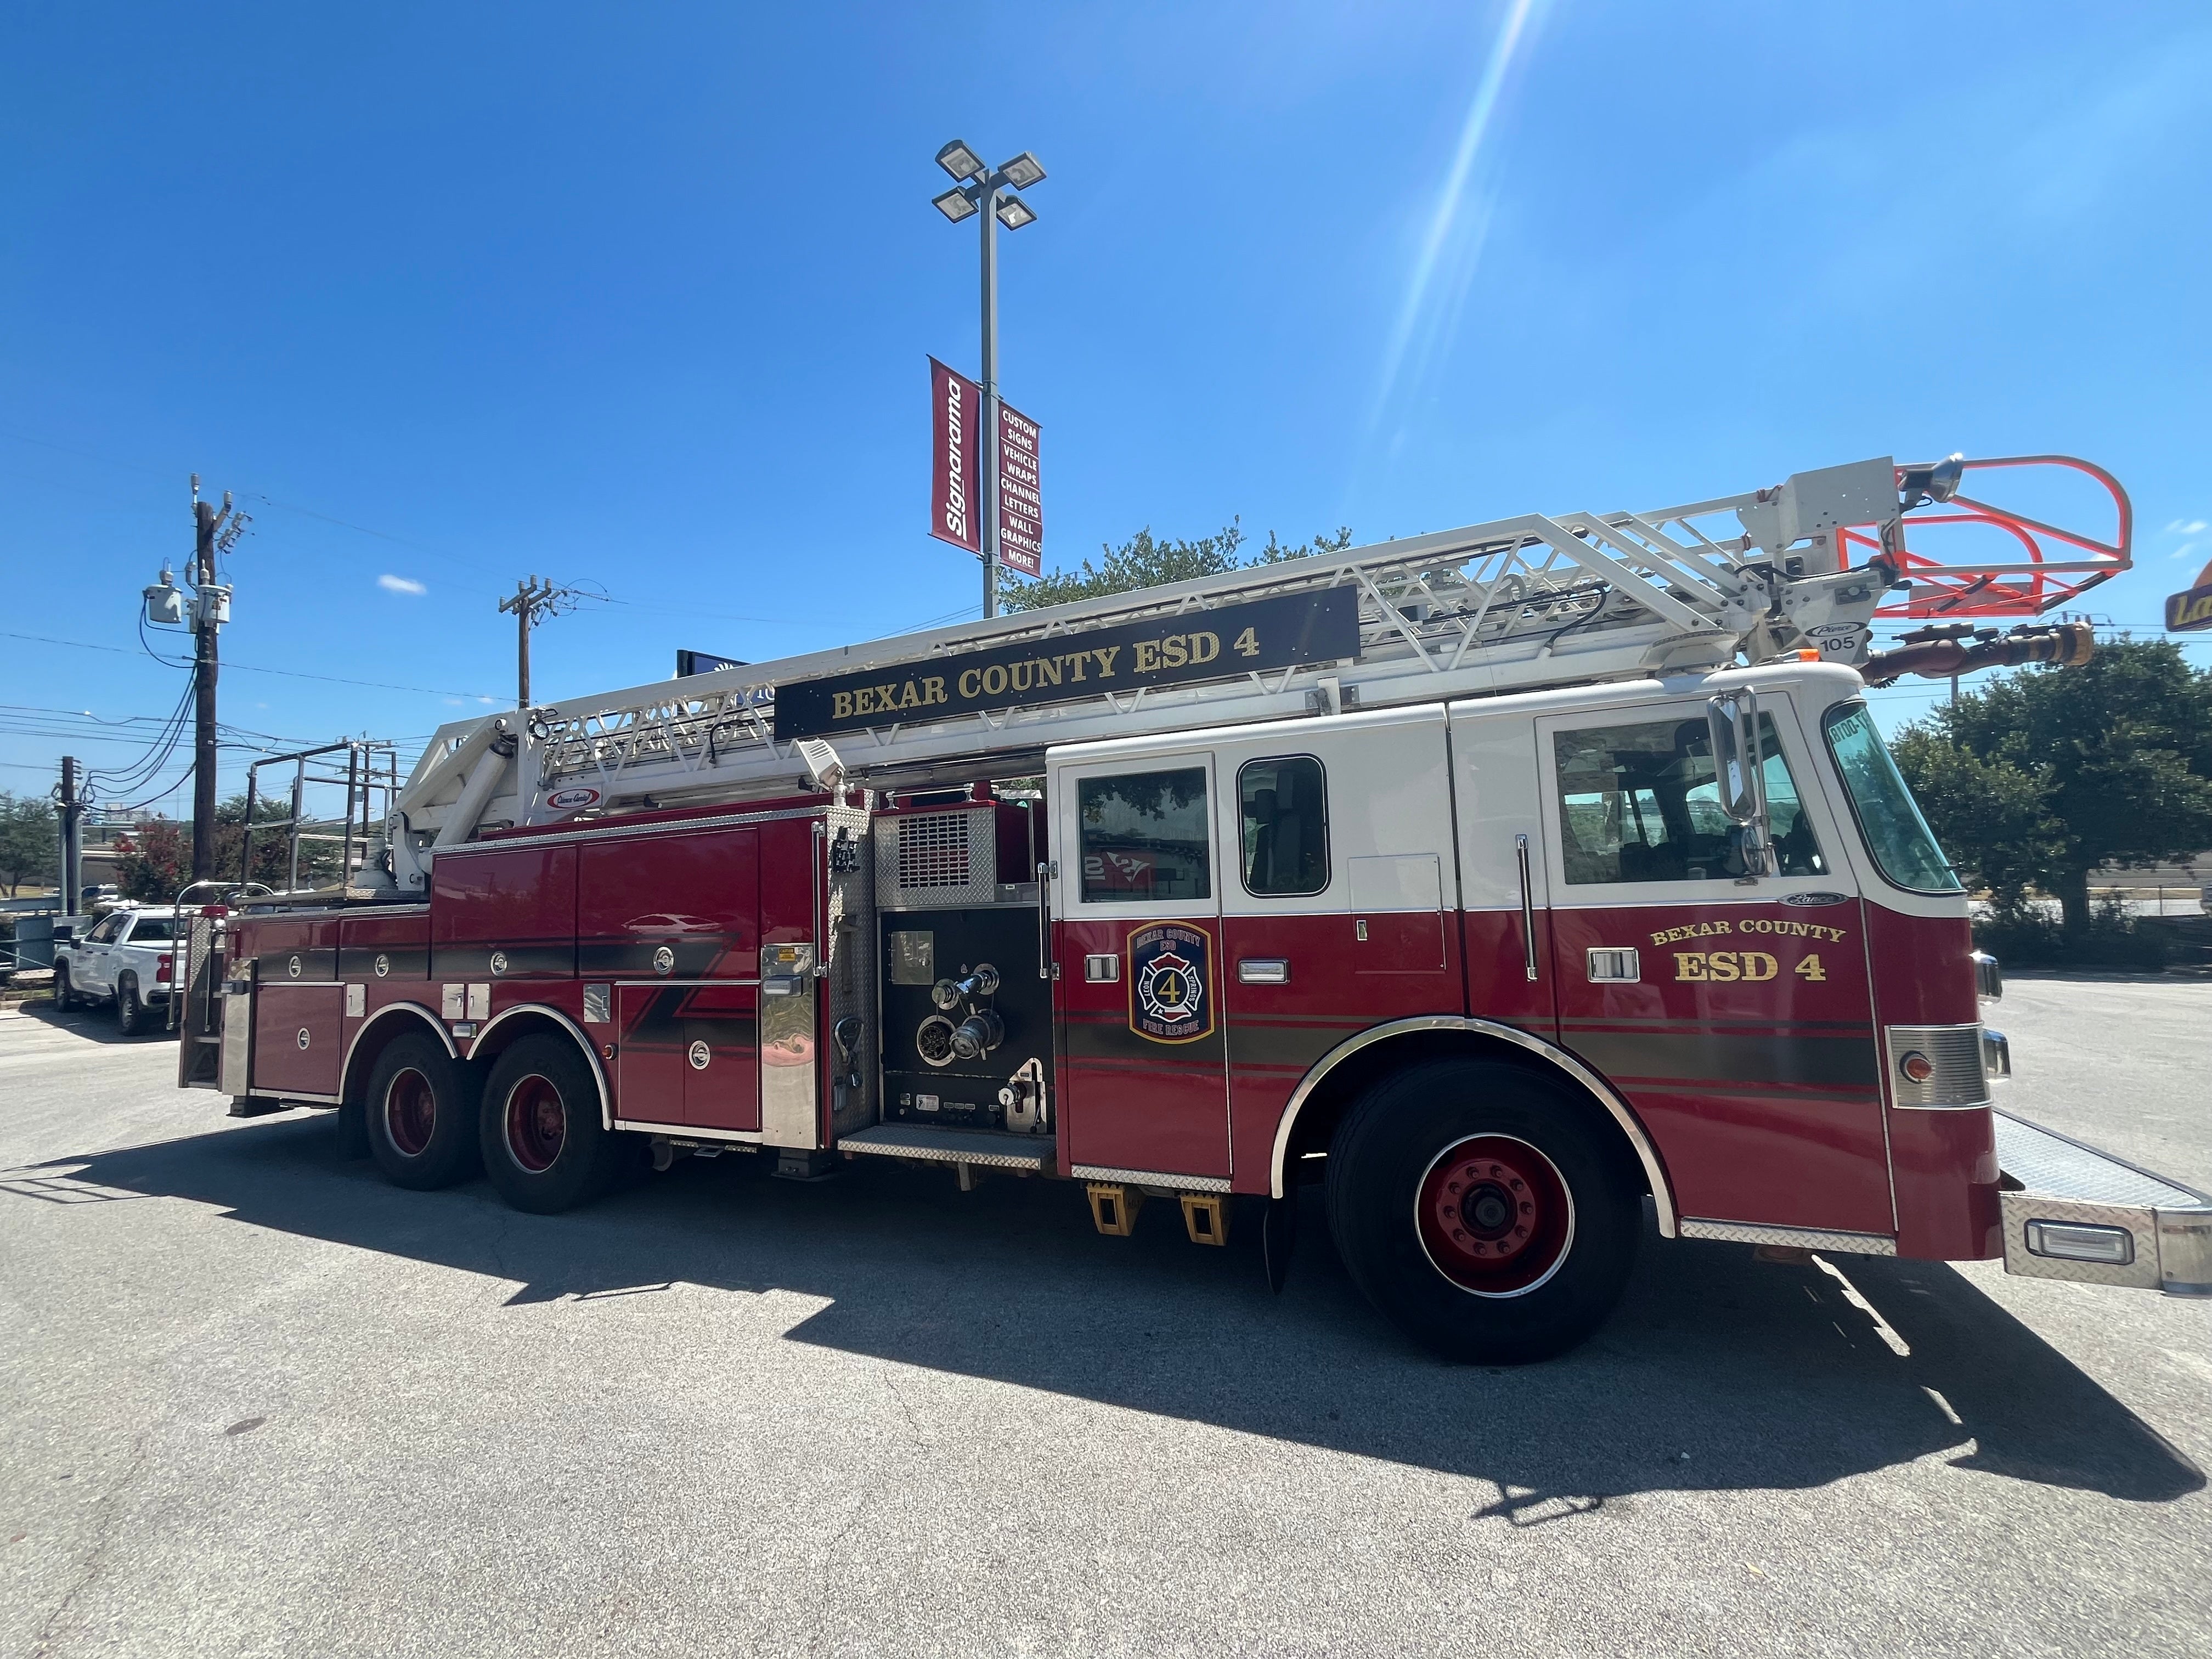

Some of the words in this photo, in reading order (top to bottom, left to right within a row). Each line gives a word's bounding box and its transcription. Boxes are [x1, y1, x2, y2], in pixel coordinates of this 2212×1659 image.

[1002, 410, 1036, 439] CUSTOM
[1007, 428, 1032, 450] SIGNS
[946, 377, 967, 541] Signarama
[1003, 444, 1037, 471] VEHICLE
[1007, 461, 1037, 485] WRAPS
[1001, 477, 1041, 505] CHANNEL
[1005, 494, 1039, 518] LETTERS
[1009, 515, 1034, 535] WALL
[1001, 528, 1041, 552] GRAPHICS
[1008, 549, 1034, 568] MORE!
[1820, 636, 1855, 652] 105
[832, 676, 948, 719] BEXAR
[958, 646, 1121, 698] COUNTY
[1132, 631, 1220, 673] ESD
[1233, 627, 1260, 657] 4
[1166, 928, 1200, 947] COUNTY
[1650, 921, 1733, 946] BEXAR
[1739, 919, 1846, 943] COUNTY
[1160, 940, 1176, 951] ESD
[1673, 952, 1778, 981] ESD
[1795, 953, 1826, 981] 4
[1158, 972, 1180, 1003] 4
[1188, 975, 1197, 1002] SPRINGS
[1143, 1018, 1164, 1035] FIRE
[1165, 1019, 1199, 1035] RESCUE
